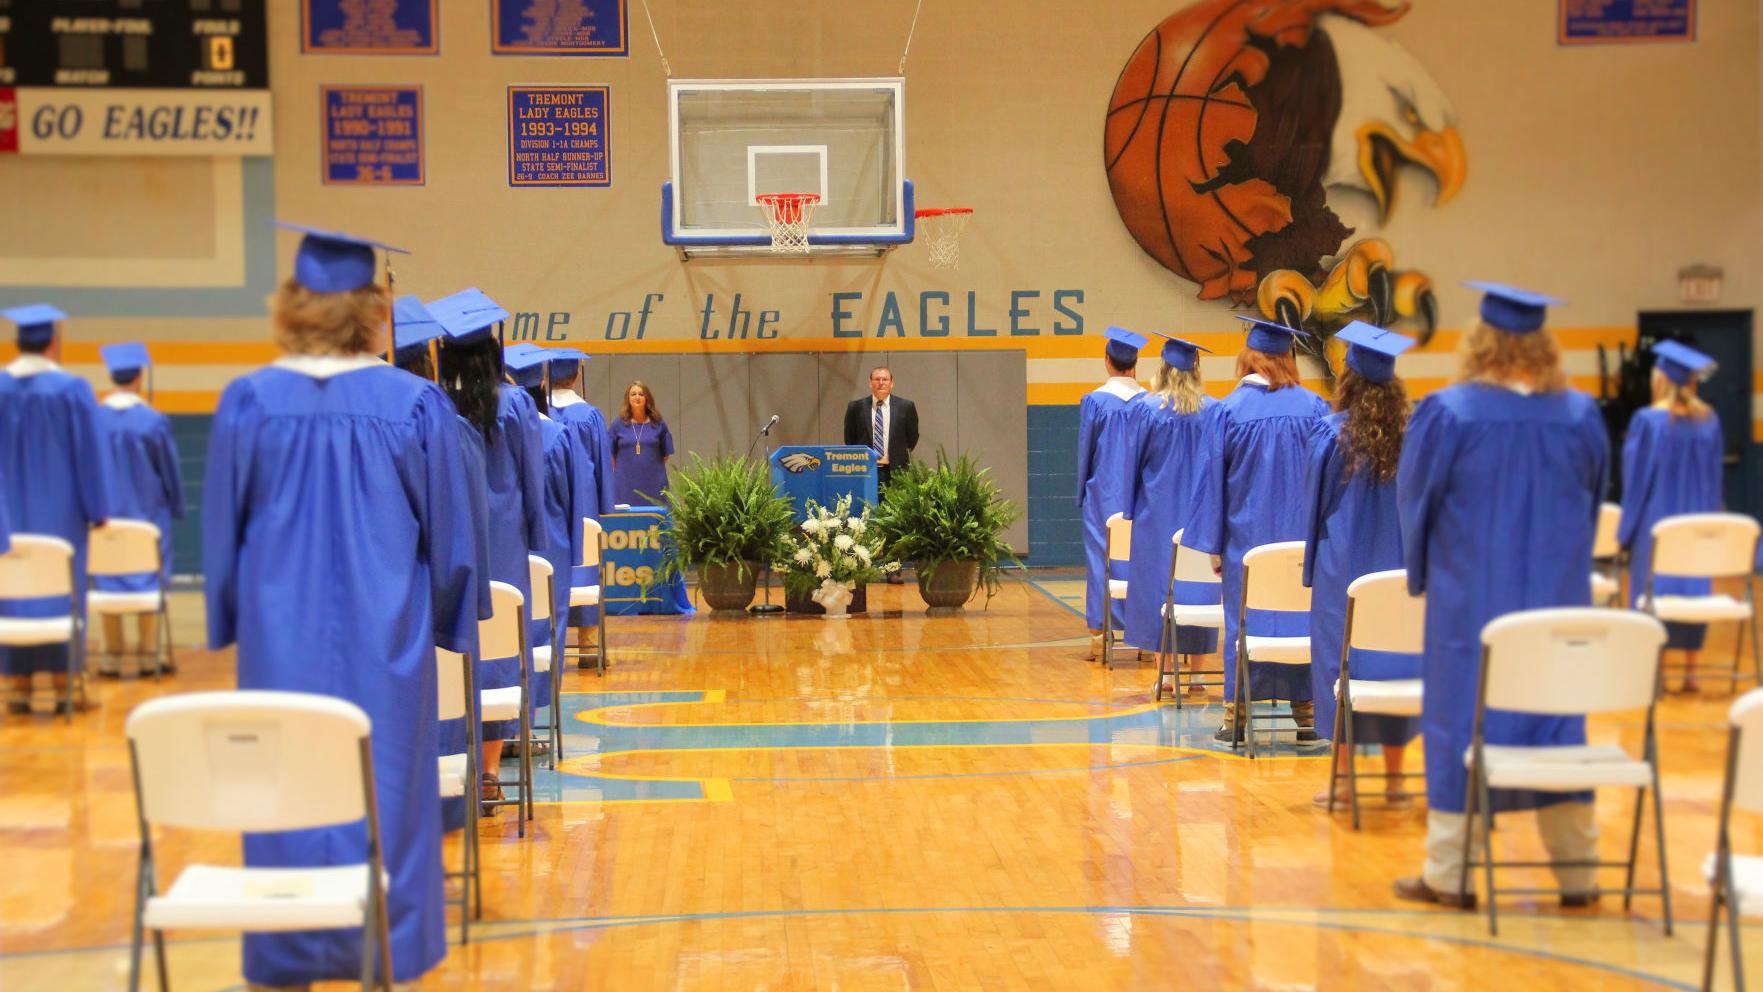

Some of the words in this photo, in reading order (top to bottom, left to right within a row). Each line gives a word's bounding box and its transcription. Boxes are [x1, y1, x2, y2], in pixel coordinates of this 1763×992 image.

[210, 36, 234, 70] 0
[527, 93, 584, 105] TREMONT
[519, 107, 549, 118] LADY
[555, 107, 599, 118] EAGLES
[32, 105, 84, 139] GO
[104, 105, 259, 140] EAGLES!!
[521, 122, 597, 135] 1993-1994
[520, 139, 549, 149] DIVISION
[571, 139, 599, 149] CHAMPS
[516, 153, 539, 162] NORTH
[541, 153, 560, 161] HALF
[562, 152, 603, 161] RUNNER-UP
[522, 162, 544, 172] STATE
[546, 162, 598, 171] SEMI-FINALIST
[537, 172, 559, 180] COACH
[604, 293, 664, 341] of
[700, 293, 780, 340] the
[831, 289, 1084, 338] EAGLES
[825, 452, 870, 461] Tremont
[831, 463, 868, 474] Eagles
[603, 561, 654, 587] les
